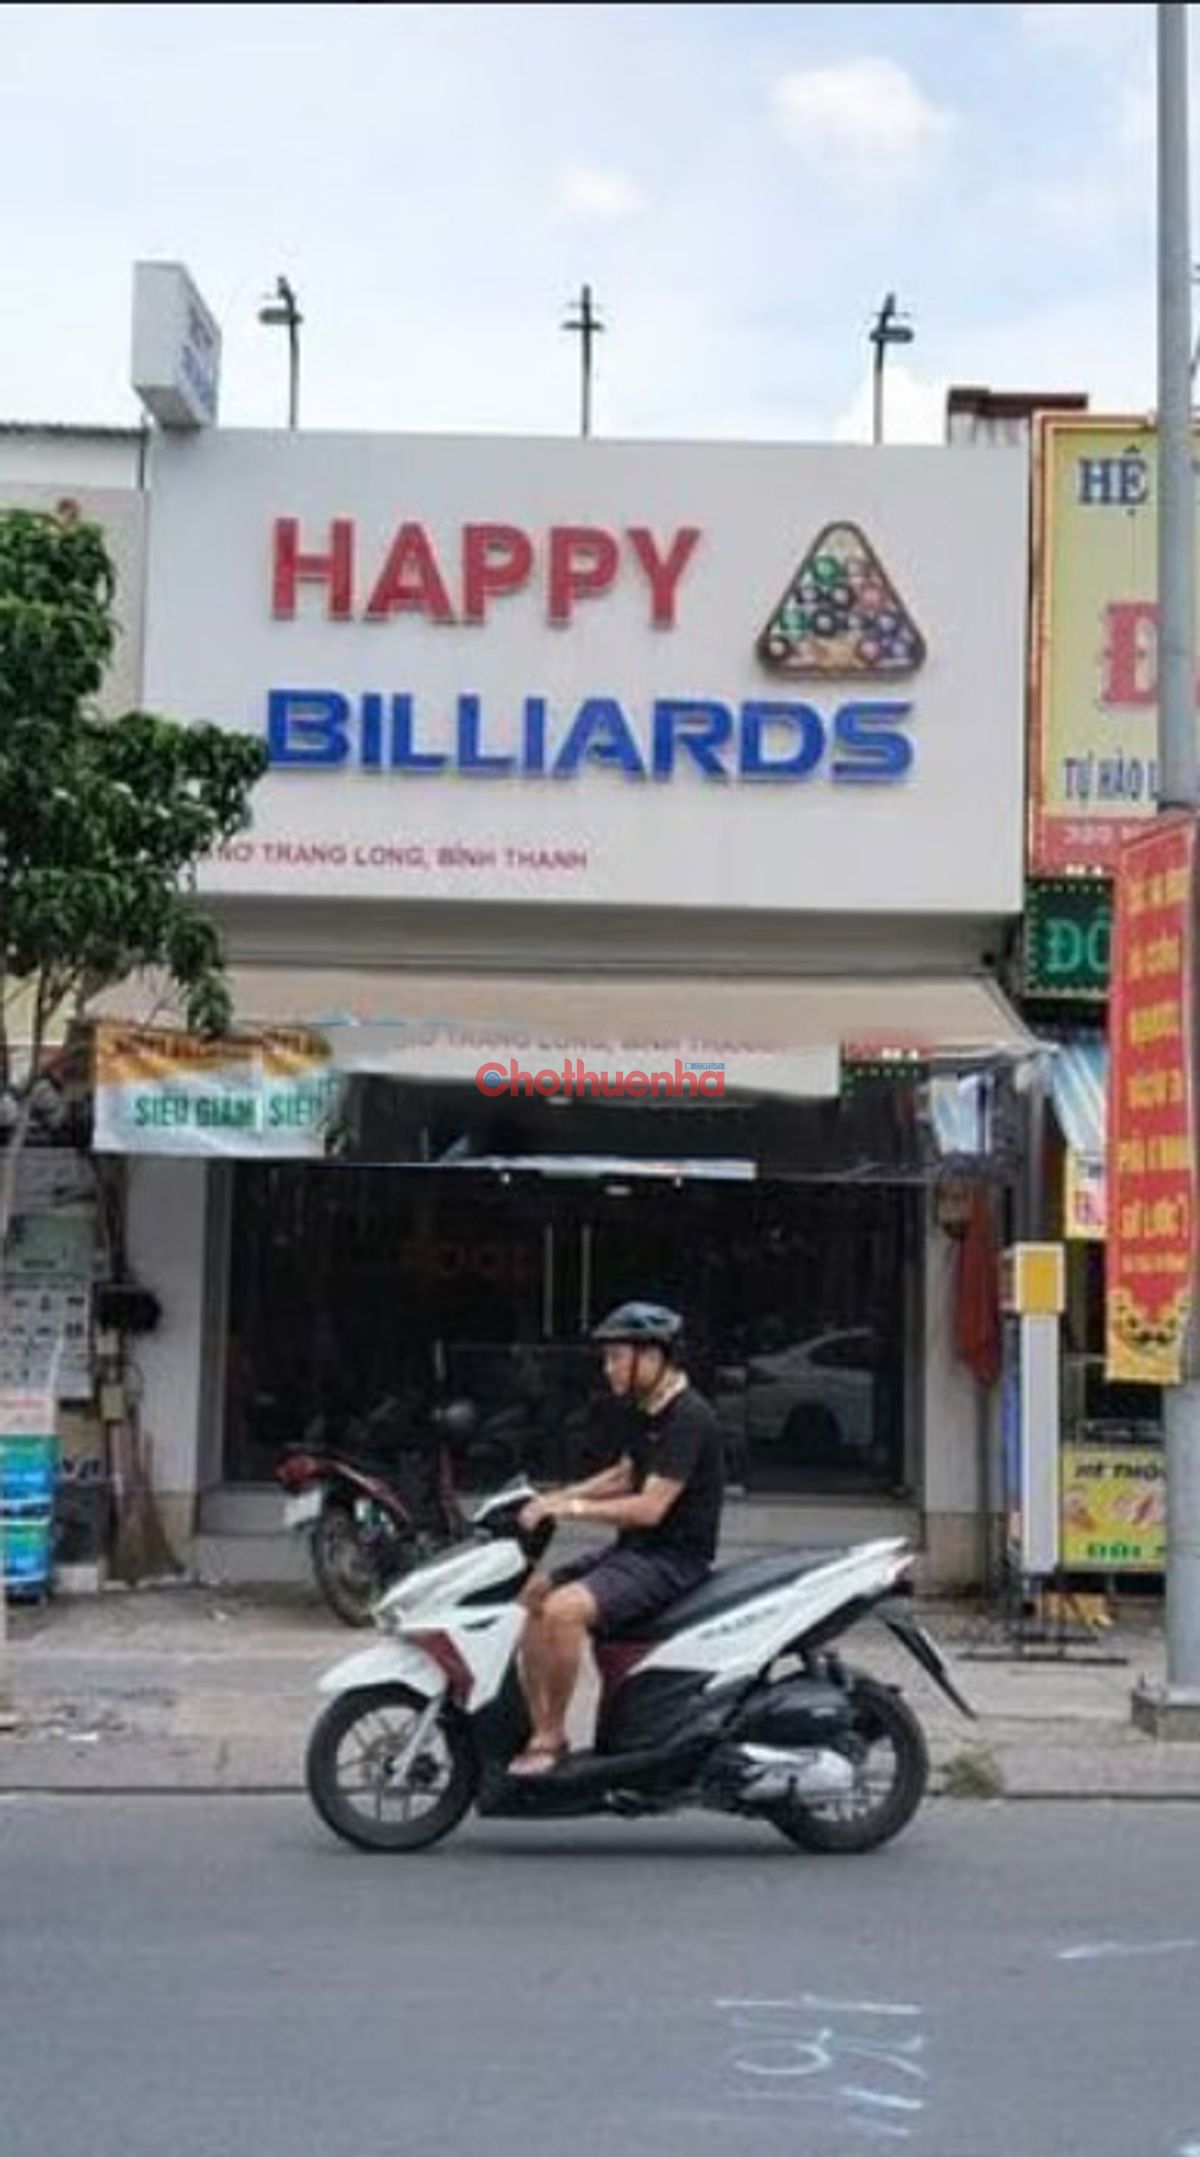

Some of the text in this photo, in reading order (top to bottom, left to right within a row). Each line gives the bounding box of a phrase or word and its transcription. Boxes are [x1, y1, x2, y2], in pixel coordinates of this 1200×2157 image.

[271, 517, 703, 629] HAPPY
[266, 687, 916, 785] BILLIARDS
[263, 841, 347, 866] TRANG
